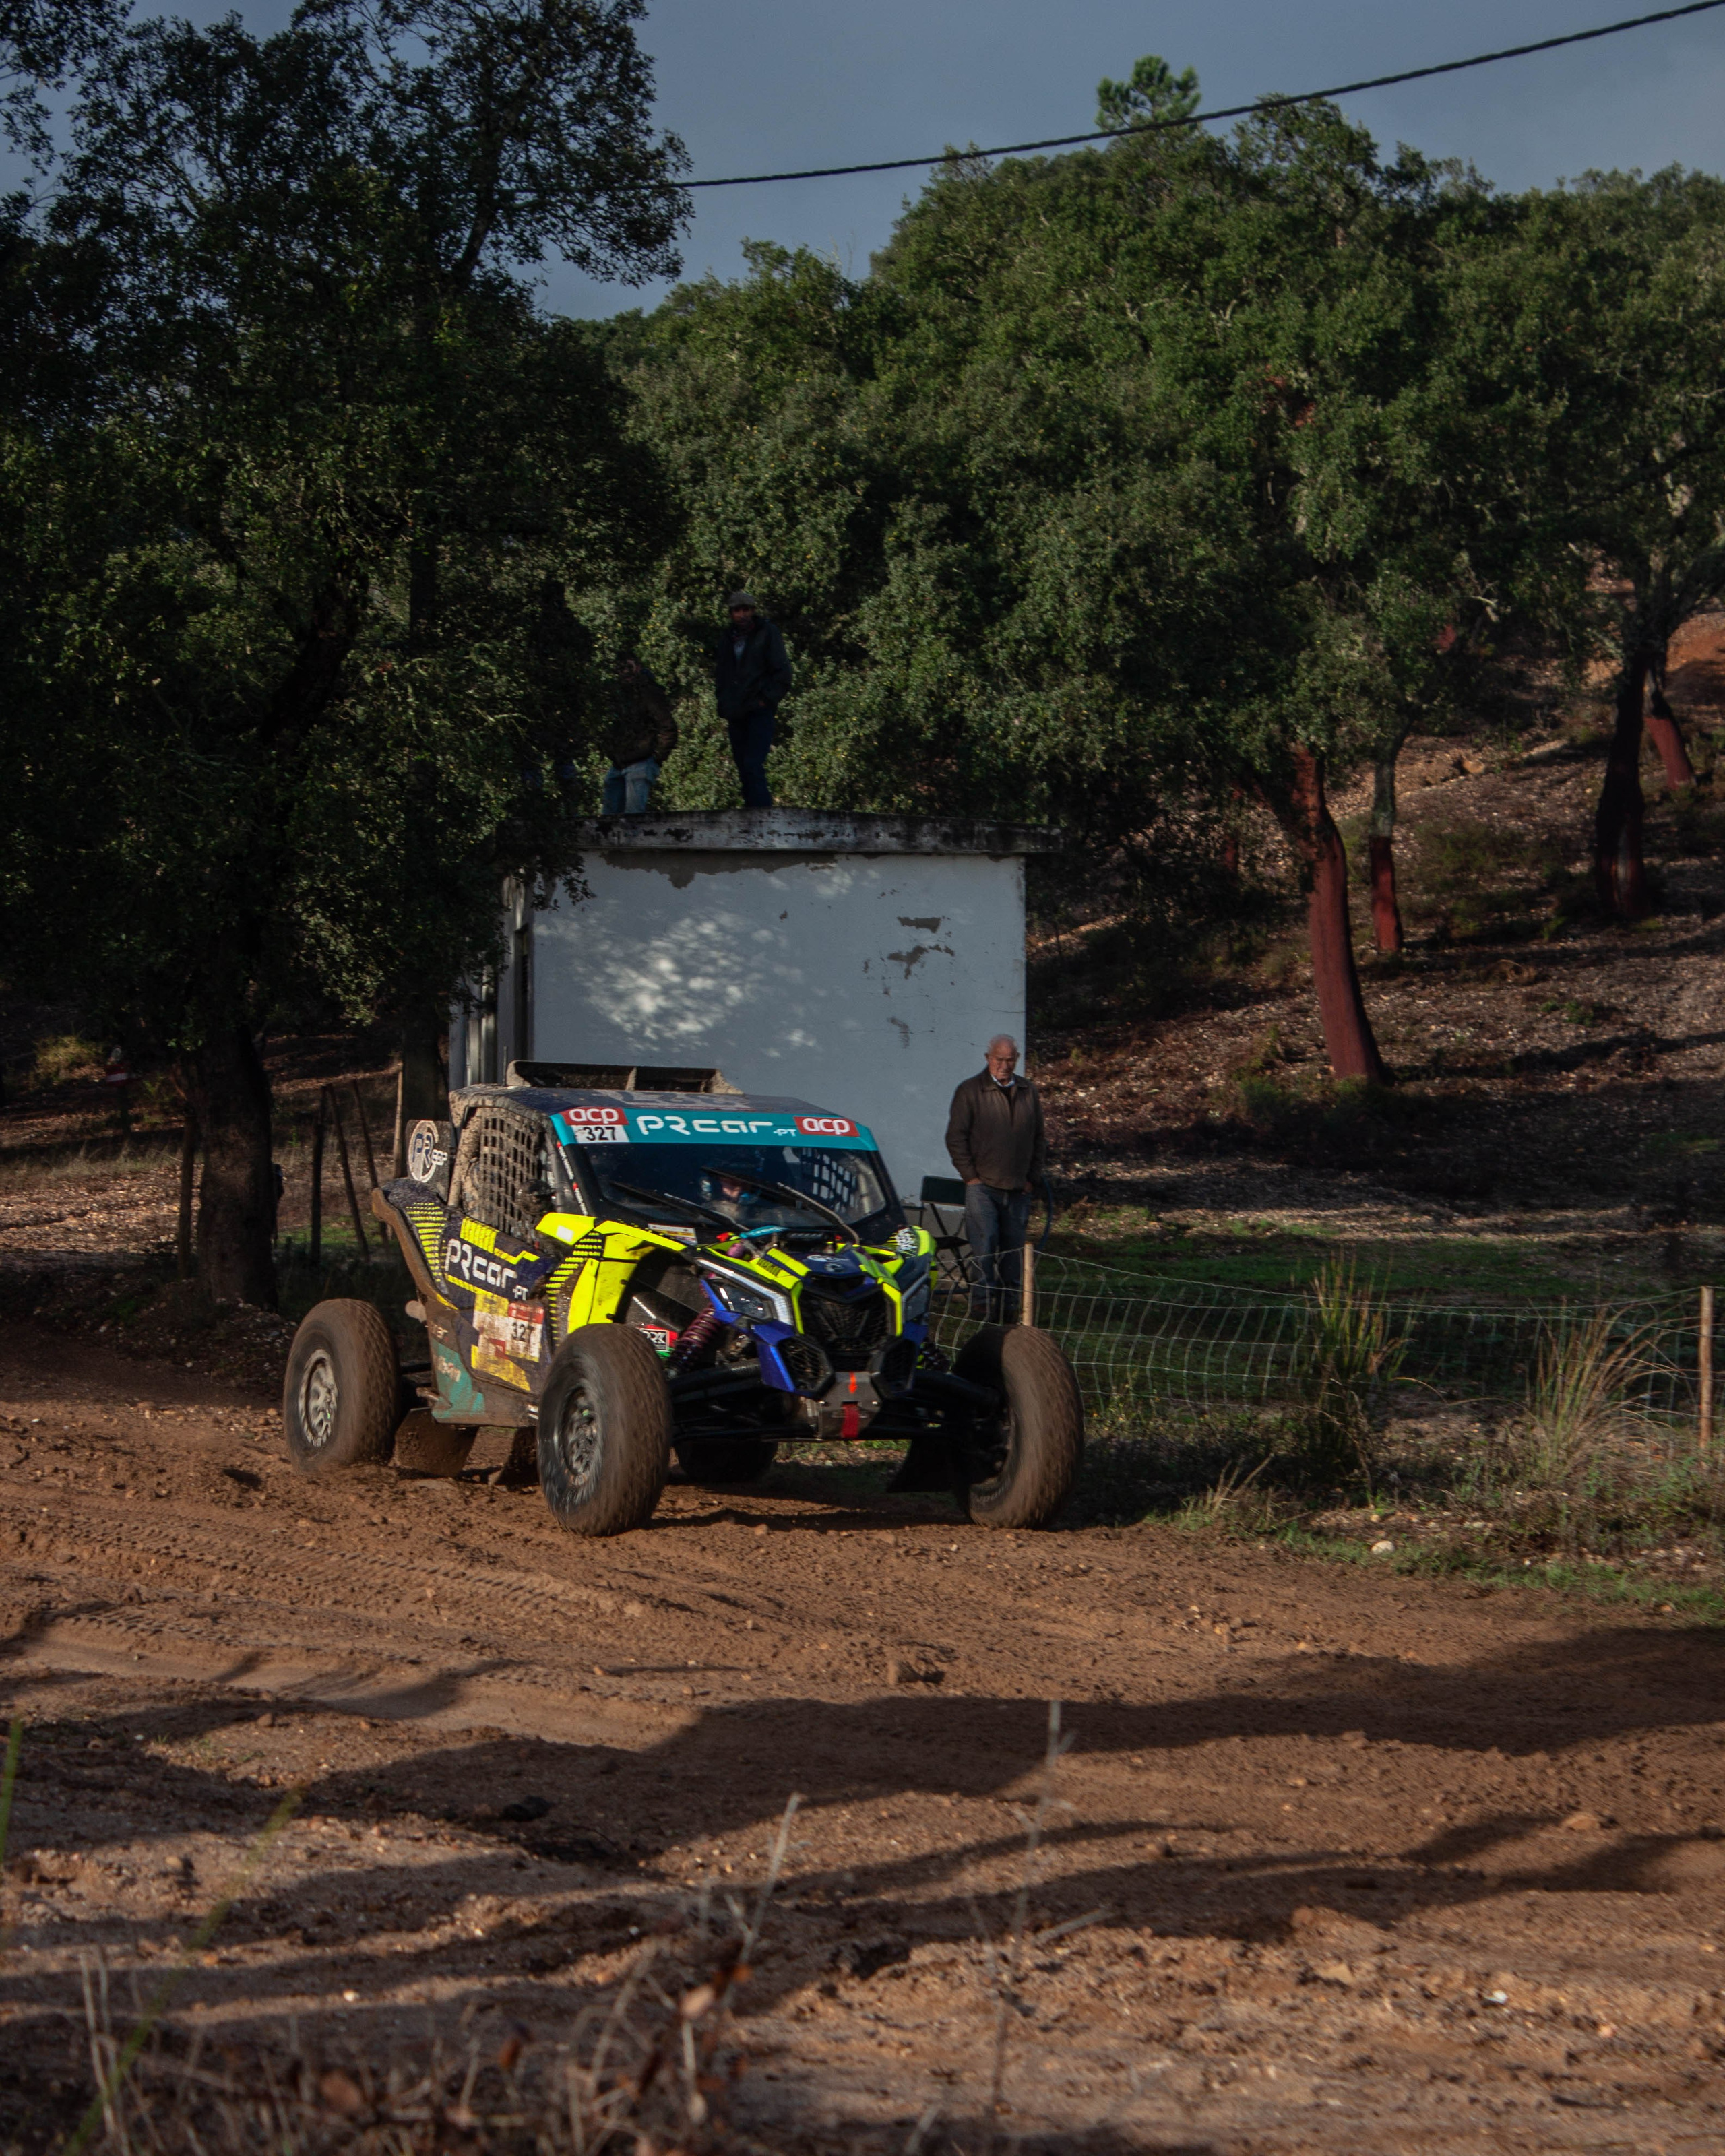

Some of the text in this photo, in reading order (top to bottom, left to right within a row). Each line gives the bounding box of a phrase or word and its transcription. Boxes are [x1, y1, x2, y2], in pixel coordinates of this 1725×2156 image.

[569, 1108, 619, 1124] acp
[583, 1126, 616, 1141] 327
[802, 1118, 850, 1135] acp
[511, 1321, 536, 1343] 327
